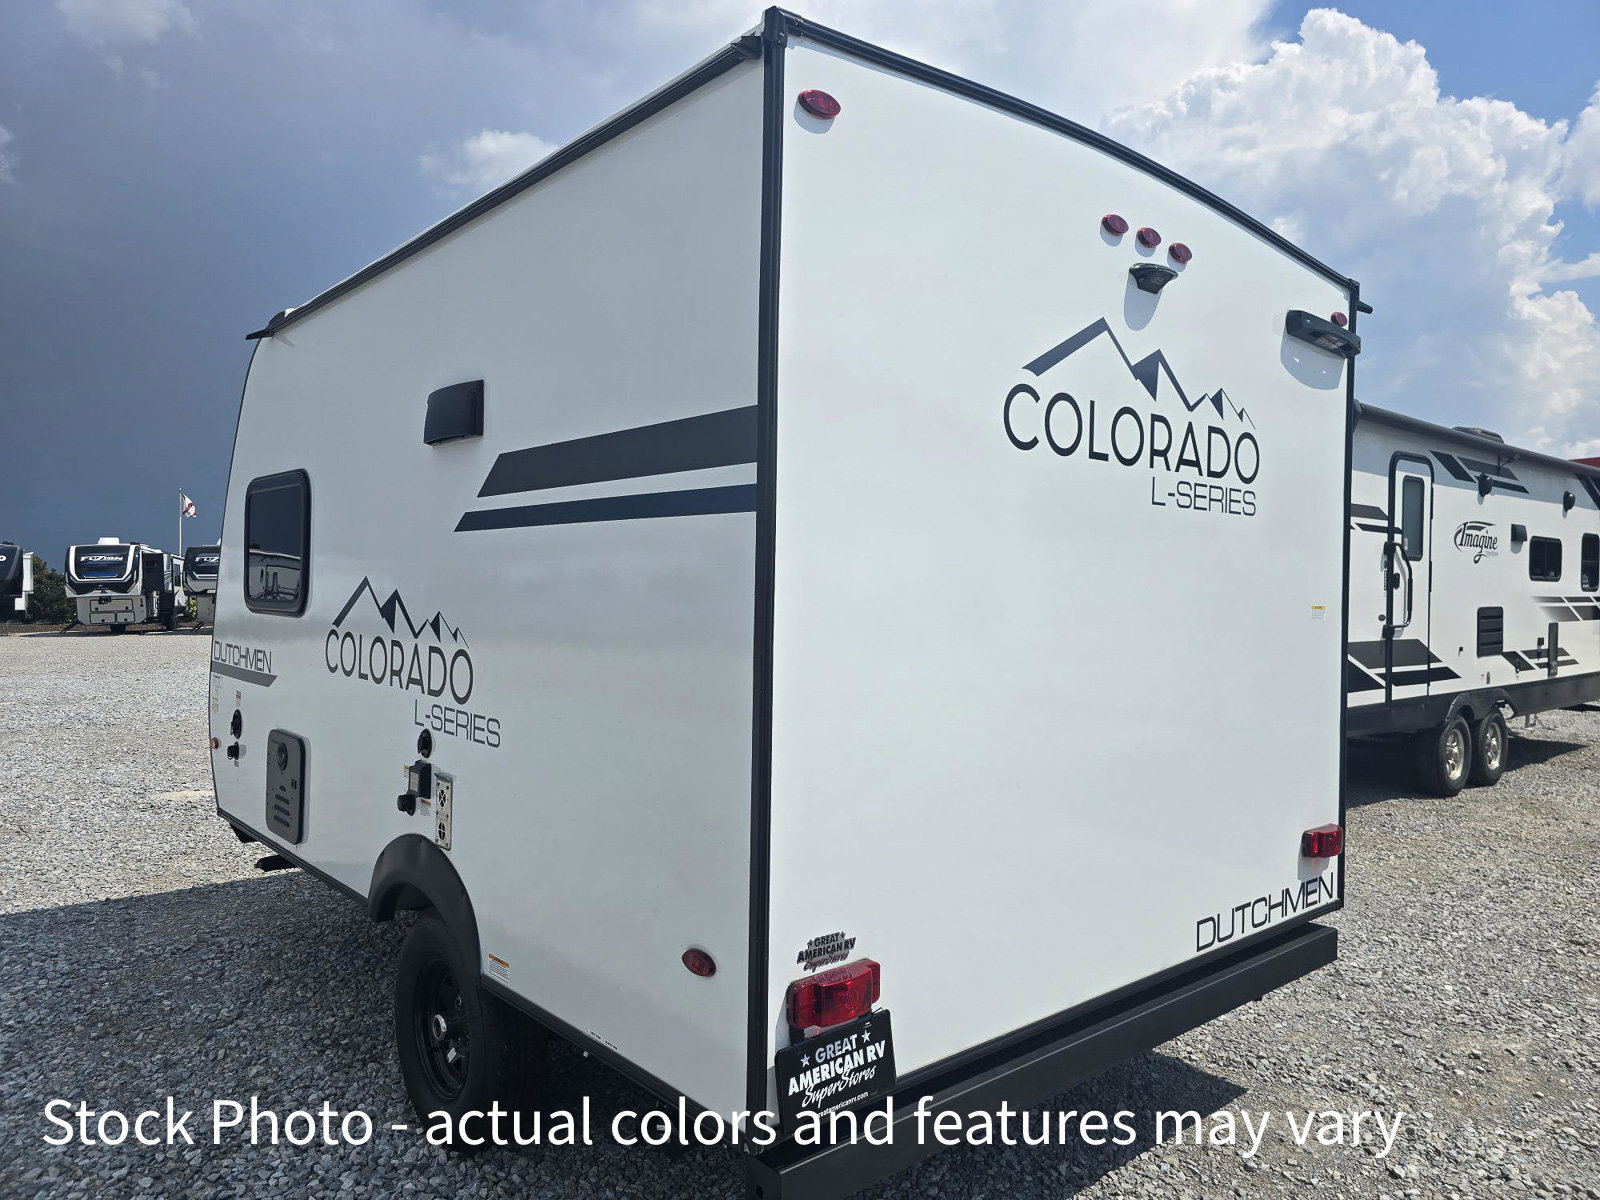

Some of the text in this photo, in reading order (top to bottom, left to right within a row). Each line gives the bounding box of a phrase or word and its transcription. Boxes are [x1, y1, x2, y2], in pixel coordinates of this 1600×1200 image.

[1003, 383, 1260, 484] COLORADO
[1151, 476, 1257, 516] L-SERIES
[1459, 521, 1499, 564] Imagine
[213, 640, 272, 673] DUTCHMEN
[325, 629, 474, 705] COLORADO
[414, 699, 501, 748] L-SERIES
[1196, 872, 1334, 952] DUTCHMEN
[797, 943, 843, 964] AMERICAN
[814, 932, 841, 947] GREAT
[844, 937, 857, 951] RV
[815, 1034, 858, 1063] GREAT
[866, 1040, 886, 1063] RV
[788, 1049, 864, 1096] AMERICAN
[801, 1065, 877, 1109] SuperStores
[815, 1091, 869, 1119] reatamericanrv.com
